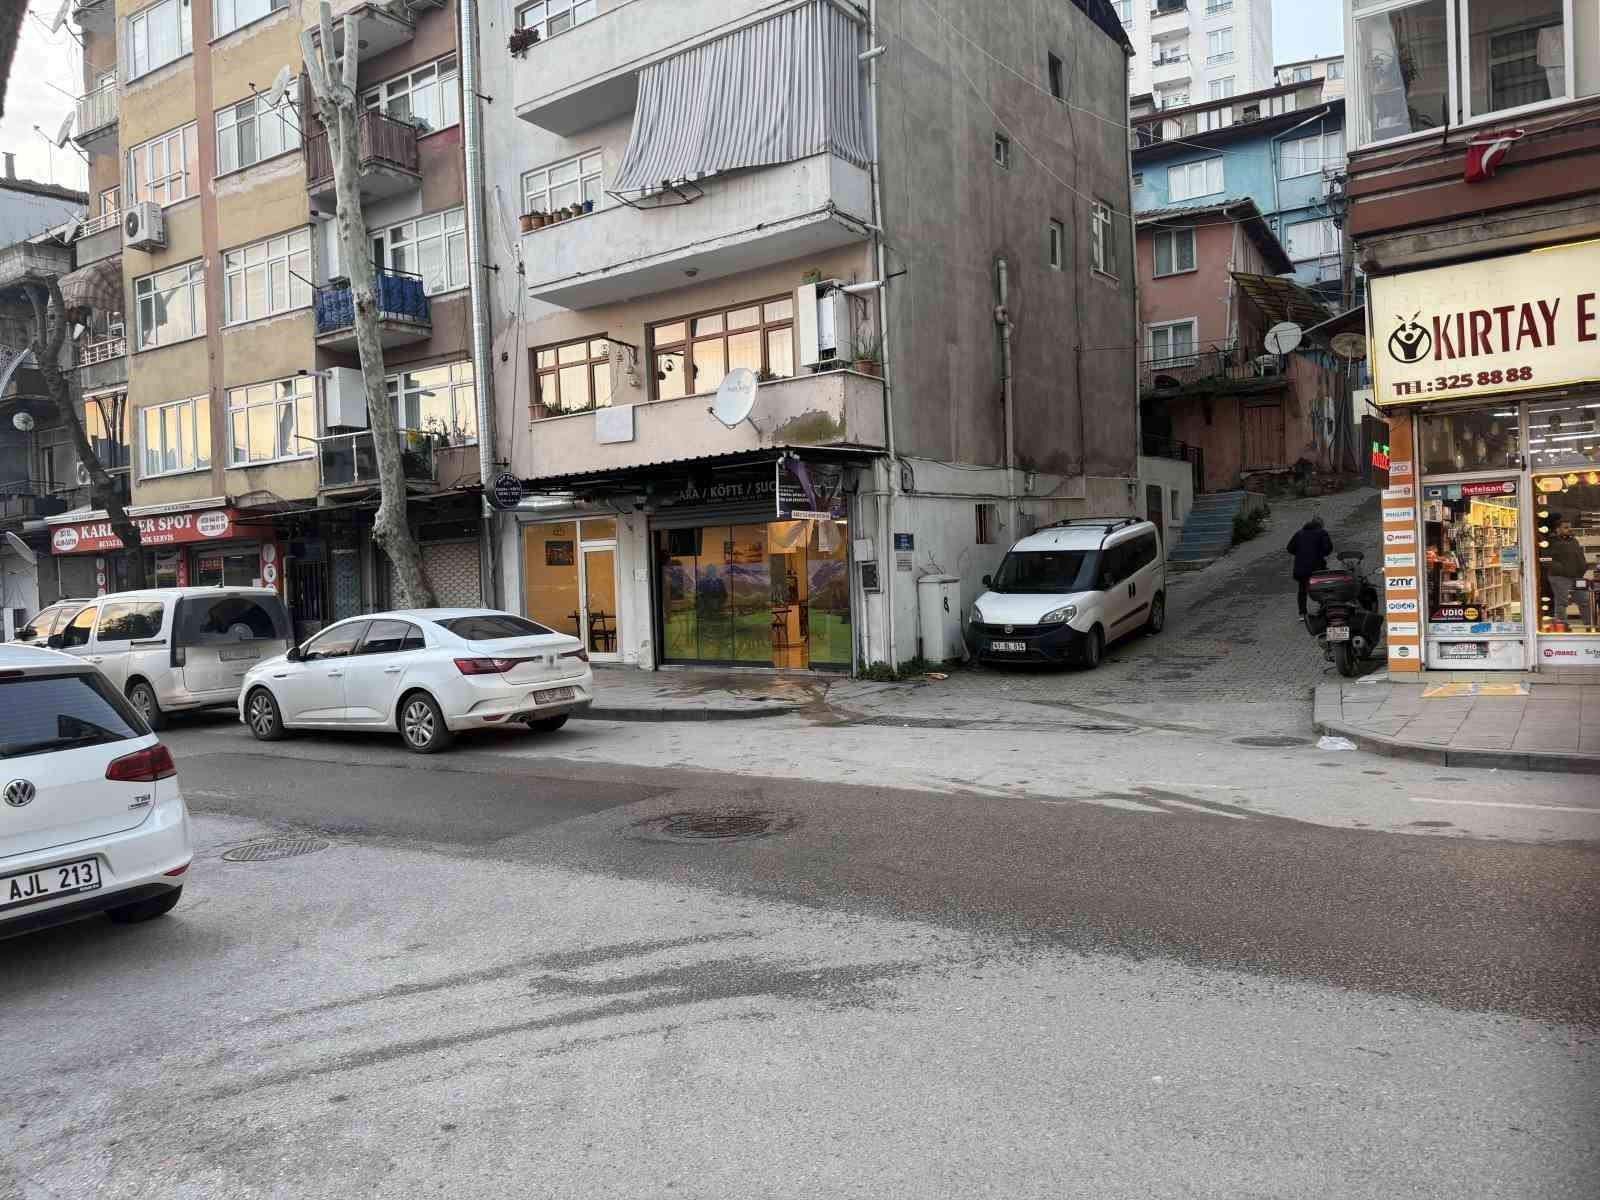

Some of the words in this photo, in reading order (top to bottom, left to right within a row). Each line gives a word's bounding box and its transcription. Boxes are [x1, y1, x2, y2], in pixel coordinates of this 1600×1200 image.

[1432, 297, 1560, 361] KIRTAY
[1435, 373, 1474, 391] 325
[1477, 369, 1503, 386] 88
[1506, 366, 1533, 382] 88
[711, 483, 743, 498] KÖFTE
[755, 480, 777, 493] SUC
[158, 514, 193, 531] SPOT
[10, 874, 48, 900] AJL
[59, 863, 93, 888] 213
